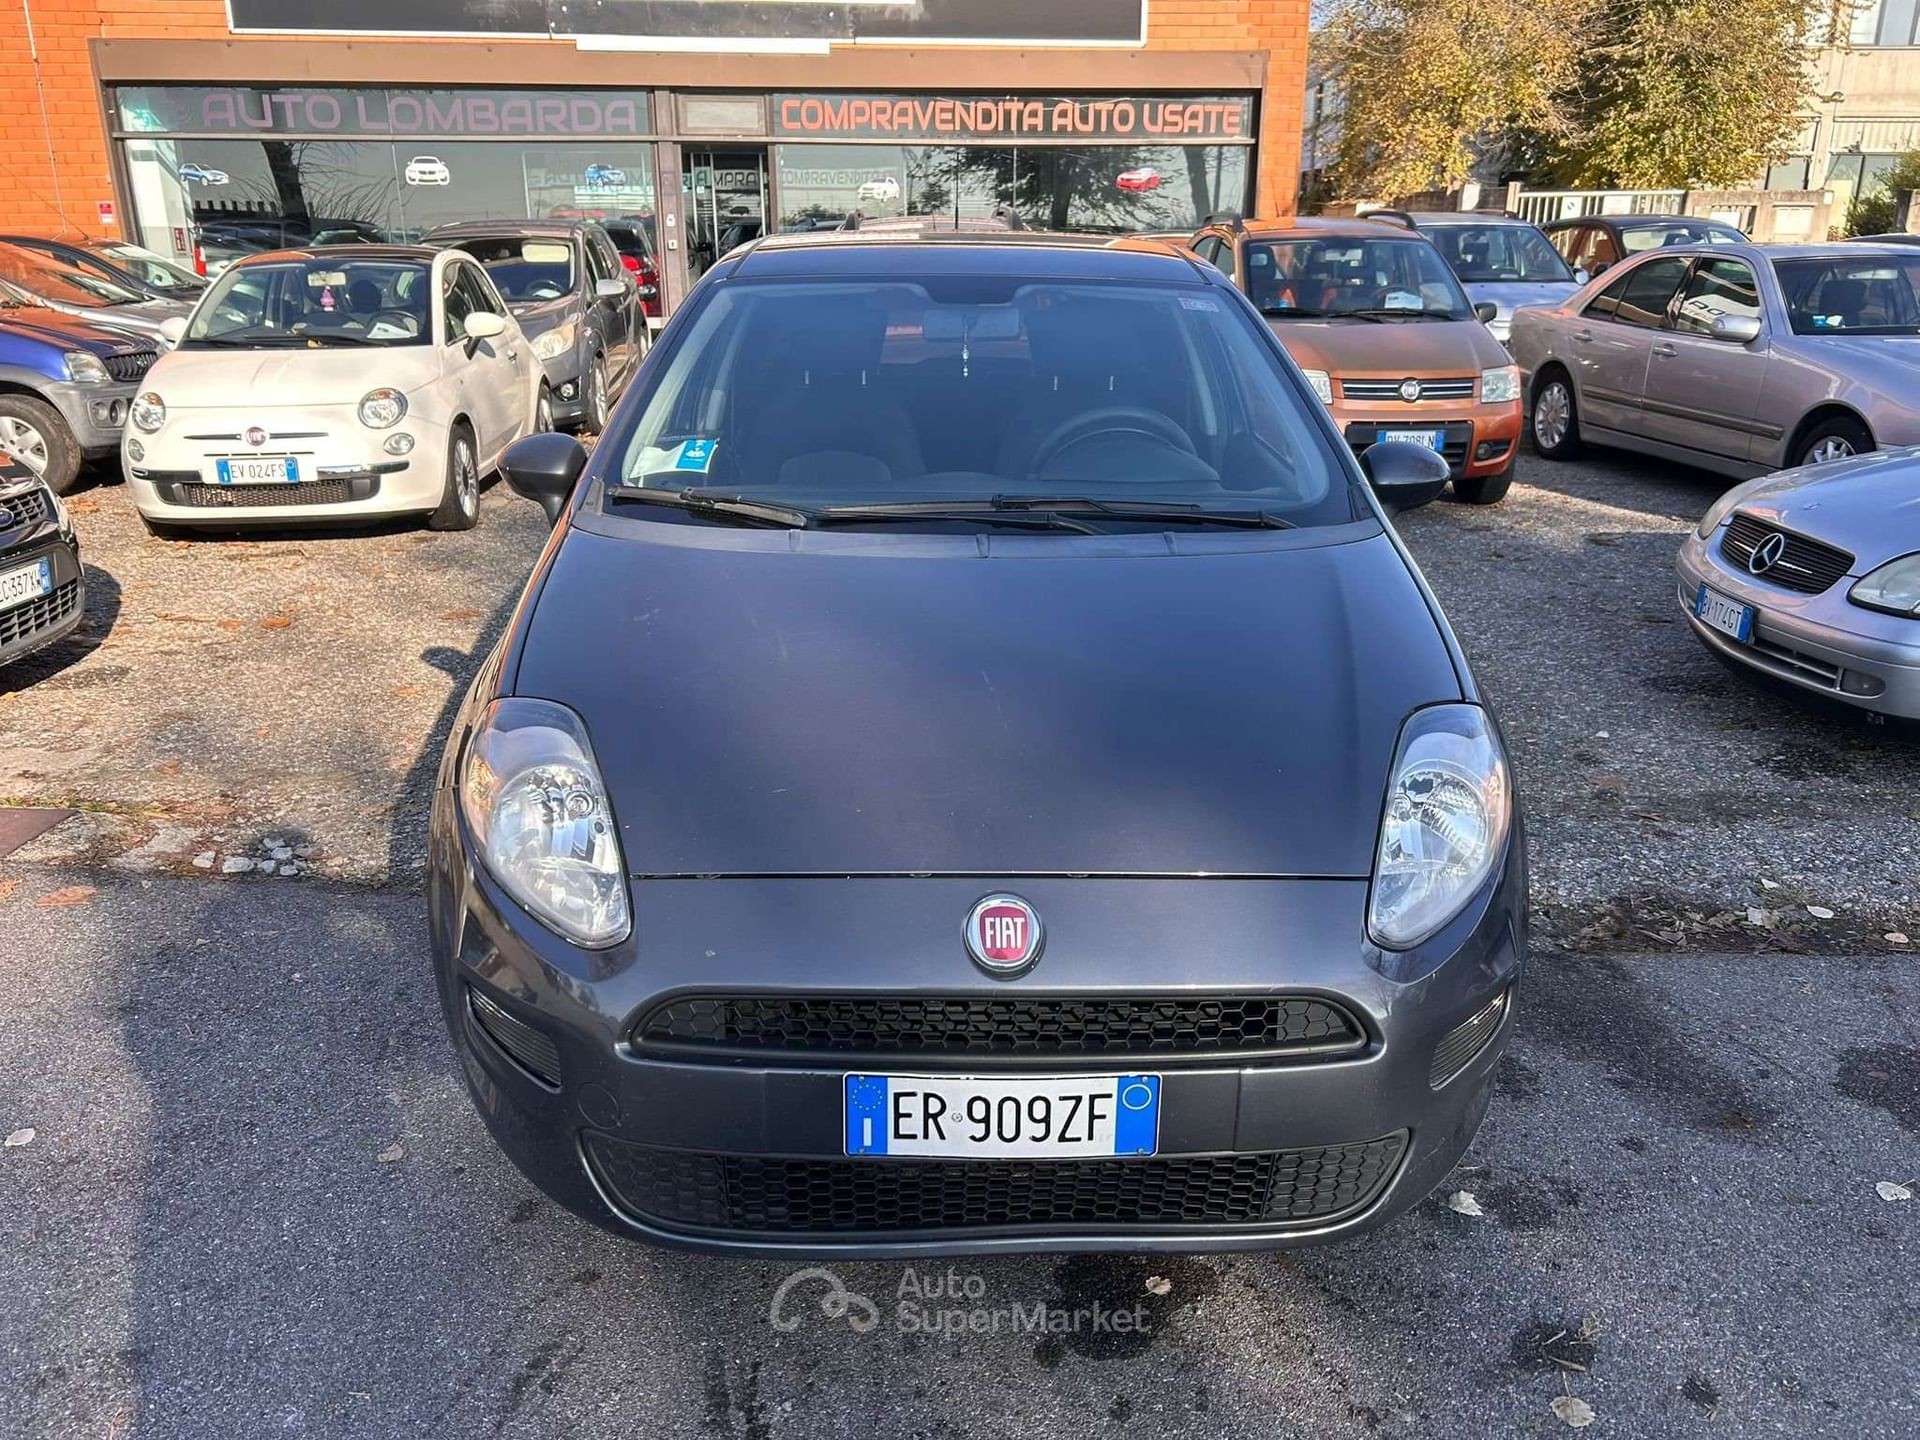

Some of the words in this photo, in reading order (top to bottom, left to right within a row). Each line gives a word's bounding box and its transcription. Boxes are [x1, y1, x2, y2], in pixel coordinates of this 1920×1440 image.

[202, 92, 341, 129] AUTO
[356, 95, 638, 133] LOMBARDA
[779, 99, 1044, 132] COMPRAVENDITA
[1052, 101, 1136, 133] AUTO
[1142, 102, 1244, 135] USATE
[230, 464, 245, 479] EV
[248, 463, 286, 479] 024FS
[984, 916, 1026, 950] FIAT
[892, 1090, 948, 1141] ER
[966, 1092, 1114, 1144] 909ZF
